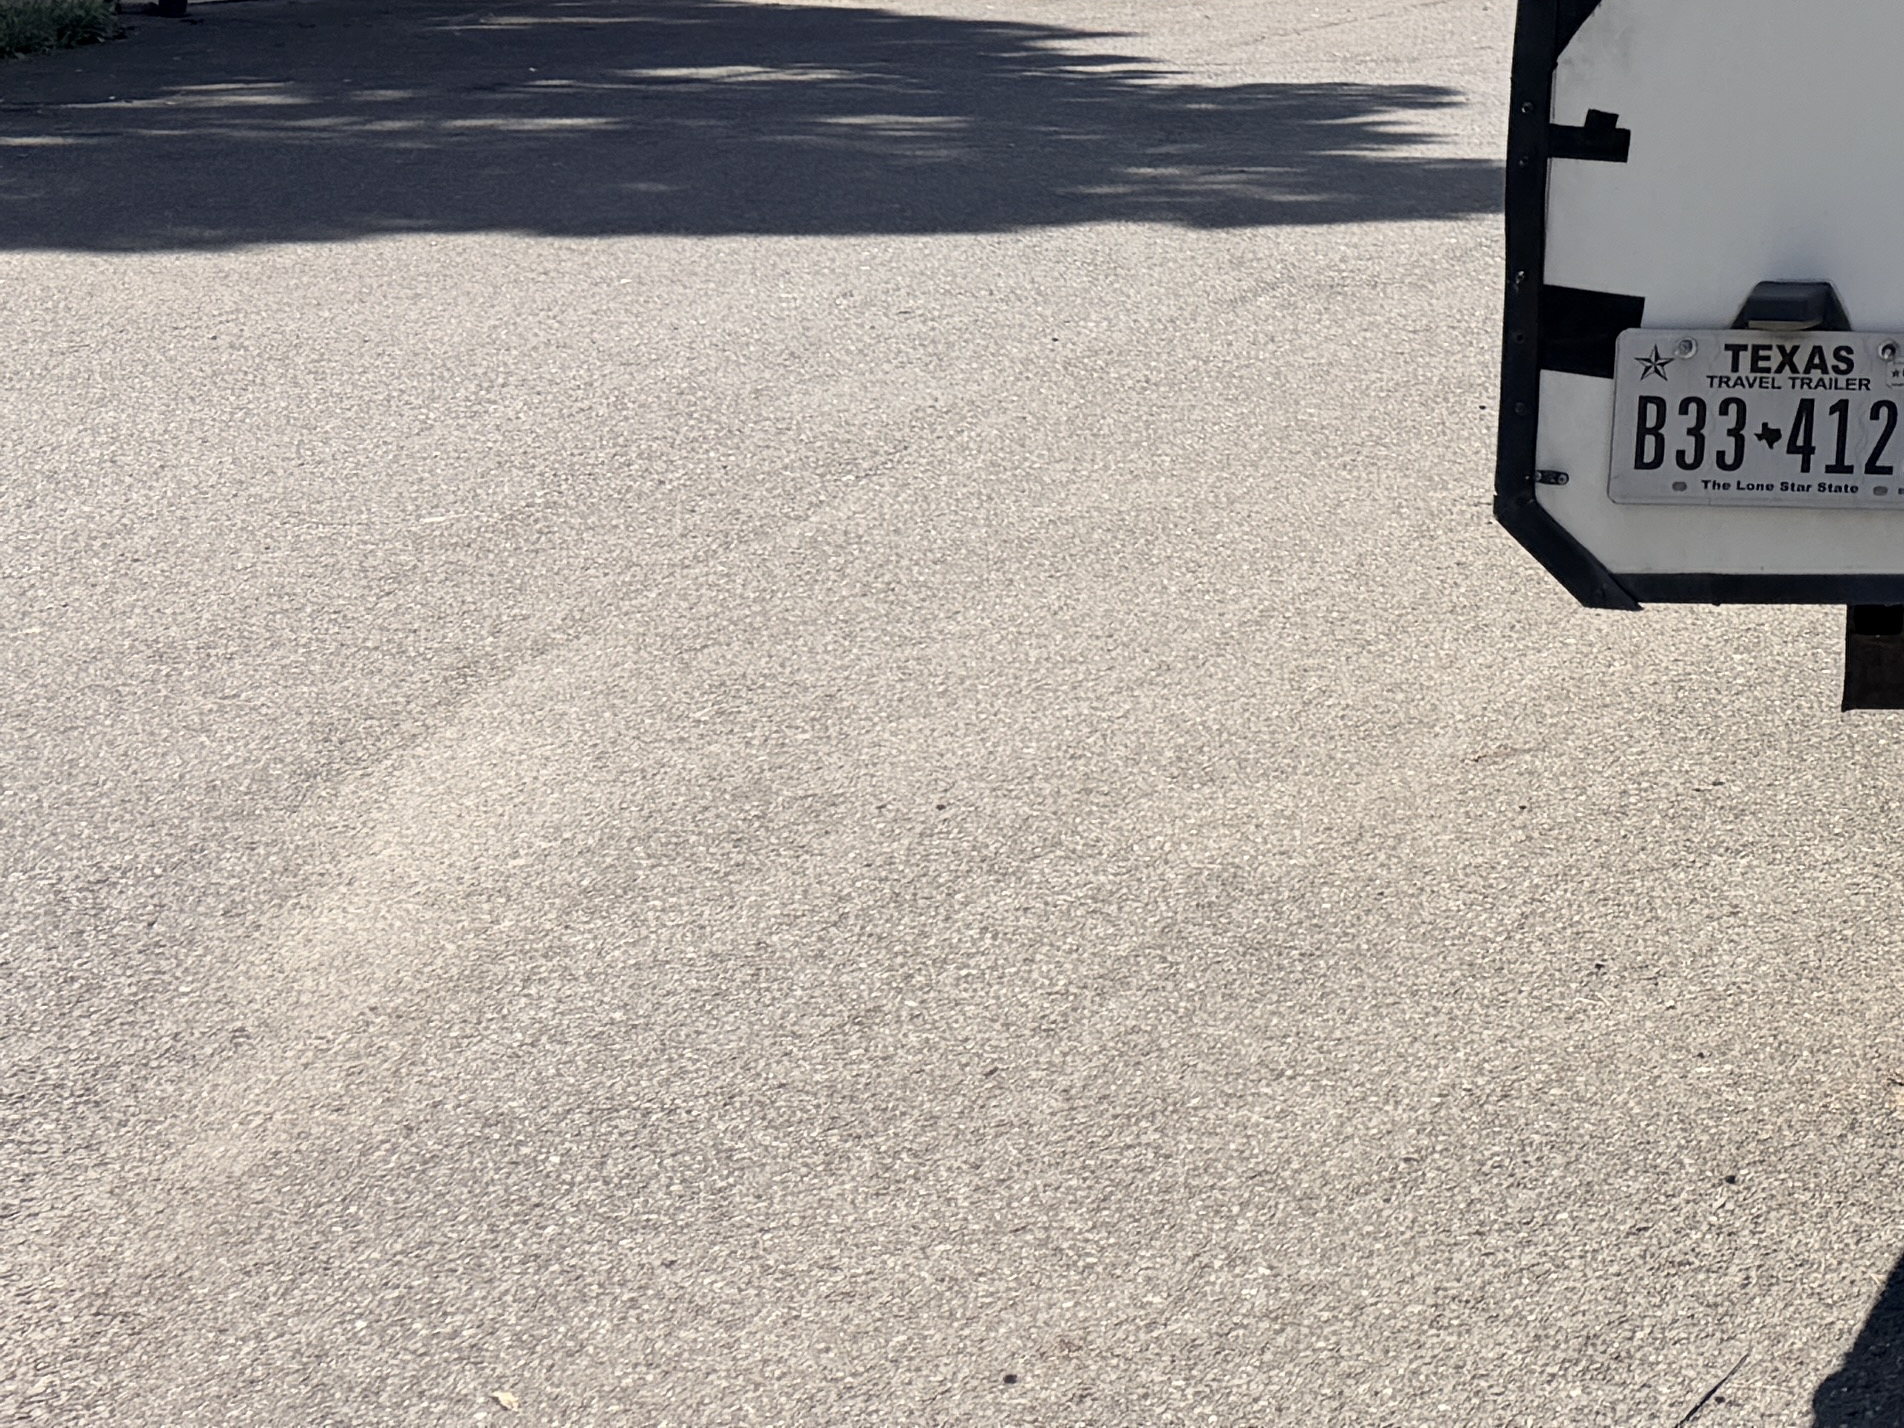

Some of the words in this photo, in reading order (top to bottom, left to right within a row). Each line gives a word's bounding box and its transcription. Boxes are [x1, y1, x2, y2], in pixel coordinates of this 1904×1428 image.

[1723, 342, 1855, 376] TEXAS
[1705, 375, 1782, 390] TRAVEL
[1787, 376, 1871, 392] TRAILER
[1633, 394, 1747, 472] B33
[1701, 479, 1732, 491] The
[1736, 479, 1775, 492] Lone
[1779, 481, 1813, 494] Star
[1817, 482, 1859, 495] State
